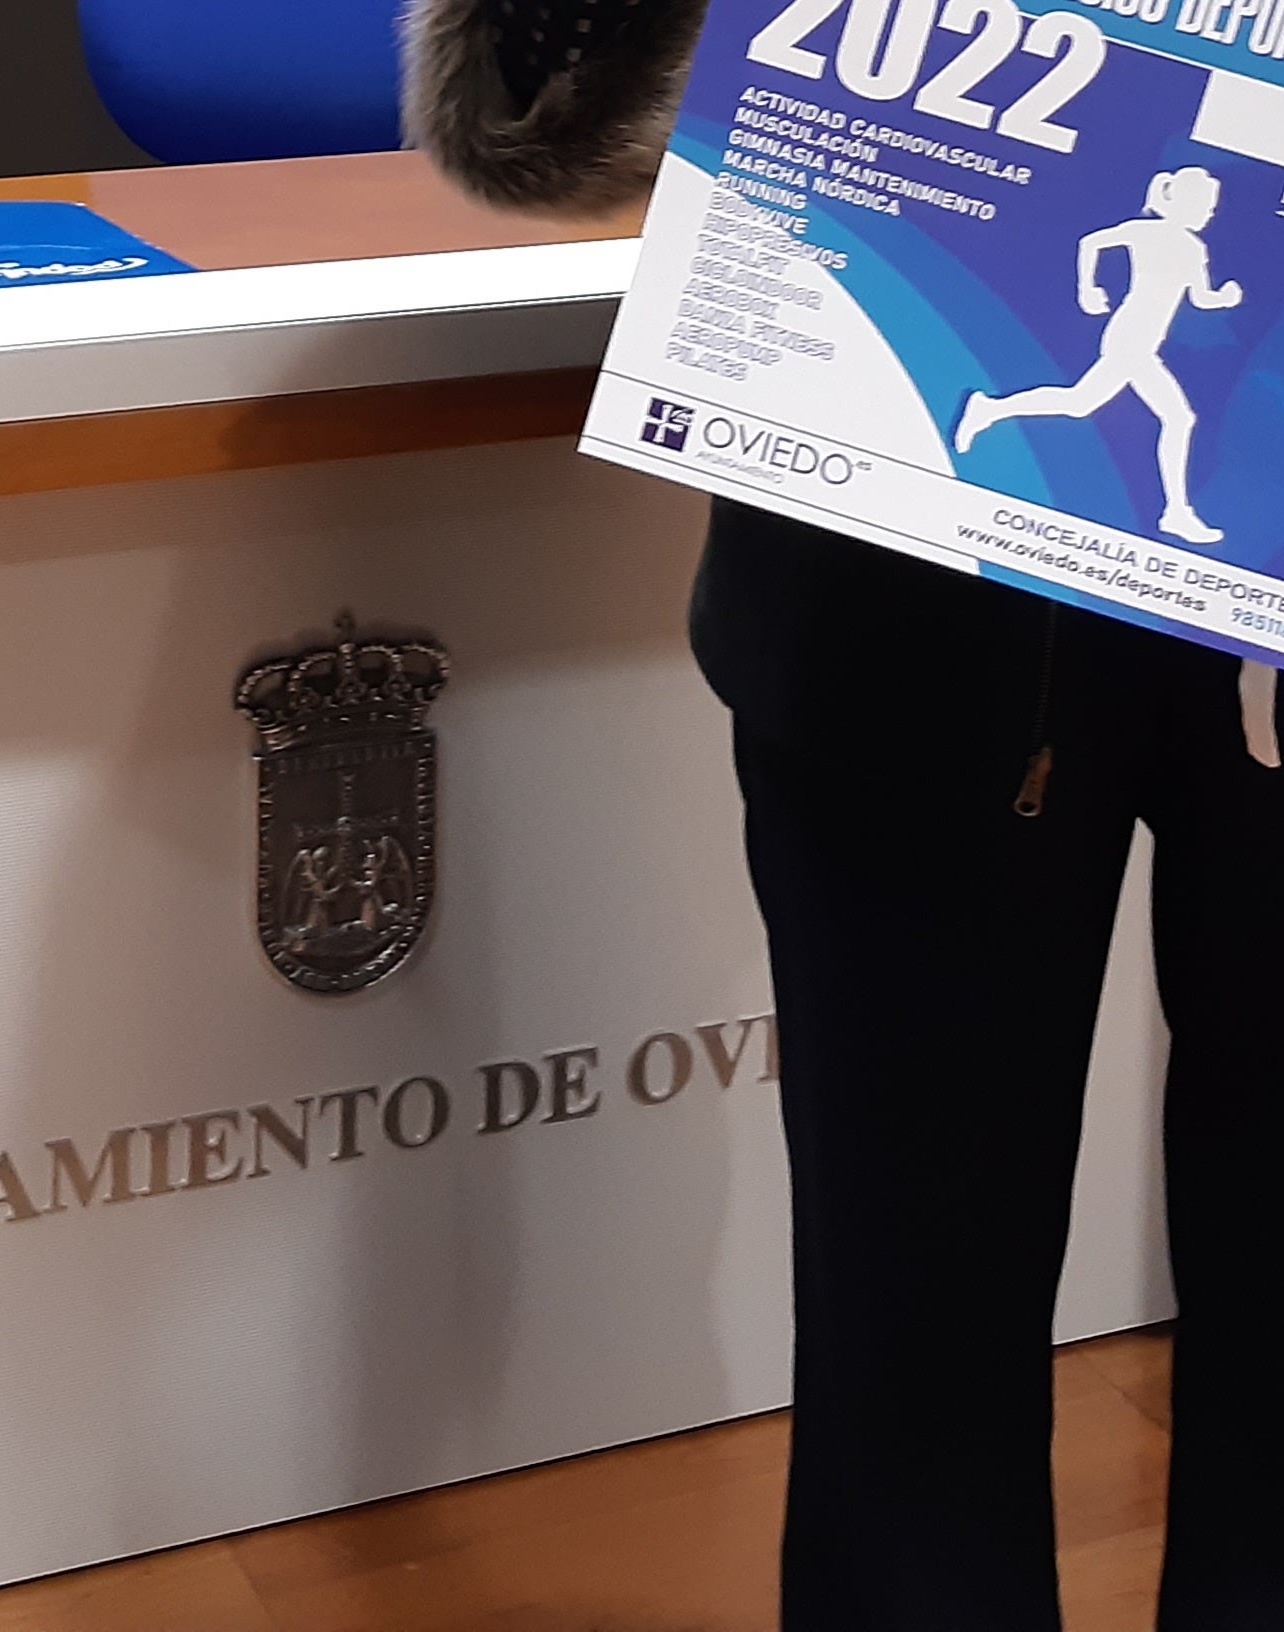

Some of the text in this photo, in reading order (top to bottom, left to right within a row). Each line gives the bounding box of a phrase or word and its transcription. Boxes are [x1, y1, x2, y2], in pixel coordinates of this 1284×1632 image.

[728, 128, 997, 221] GIMNASIA MANTENIMIENTO
[734, 106, 880, 163] MUSCULACIÓN
[738, 85, 1032, 185] ACTIVIDAD CARDIOVASCULAR
[715, 171, 808, 210] RUNNING
[722, 149, 901, 217] MARCHA NÓRDICA
[956, 524, 1208, 613] www.oviedo.es/deportes
[992, 508, 1139, 568] CONCEJALÍA
[1144, 555, 1180, 580] DE
[474, 1045, 602, 1138] DE
